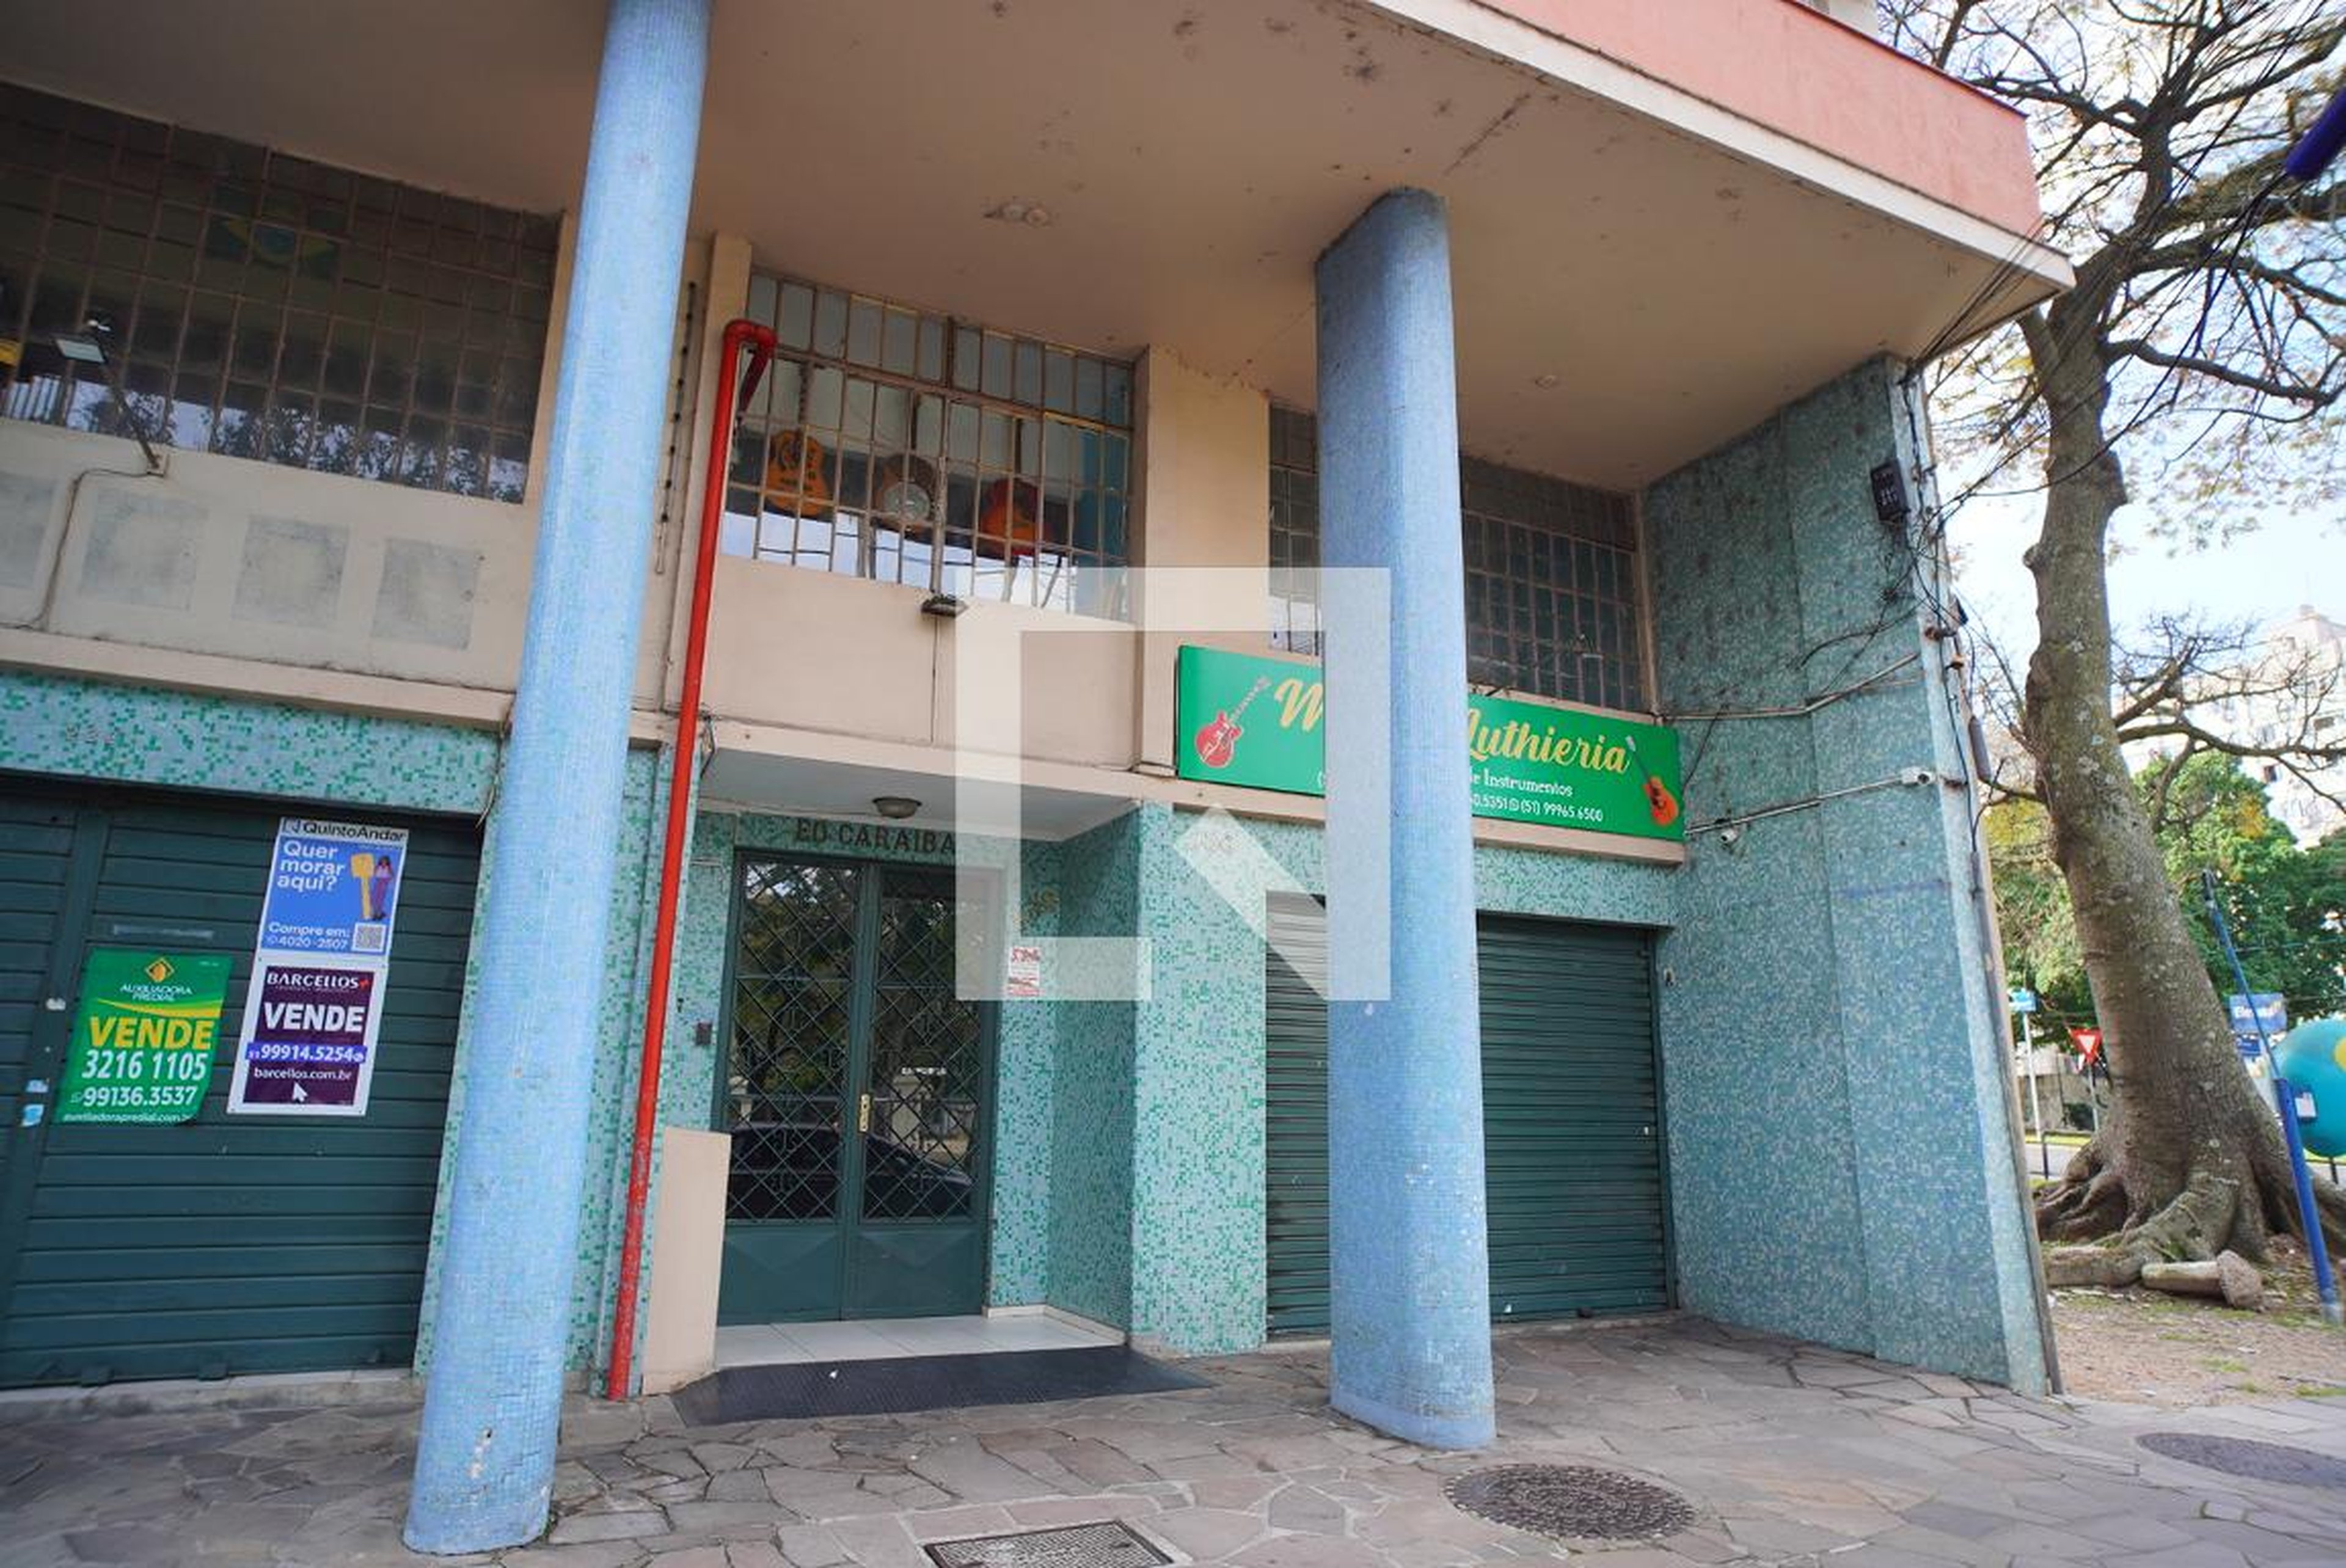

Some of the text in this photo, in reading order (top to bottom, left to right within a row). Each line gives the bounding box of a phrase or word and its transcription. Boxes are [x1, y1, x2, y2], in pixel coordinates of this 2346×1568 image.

[1483, 767, 1573, 797] Instrumentos
[304, 822, 407, 842] QuintoAndar
[283, 840, 339, 860] Quer
[280, 858, 345, 877] morar
[277, 875, 338, 892] aqui?
[269, 921, 323, 937] Compre
[266, 972, 360, 989] BARCELLOS
[263, 1002, 365, 1032] VENDE
[89, 1016, 214, 1050] VENDE
[261, 1043, 353, 1062] 99914.5254
[81, 1049, 209, 1081] 3216 1105
[254, 1067, 353, 1081] barcellos.com.br
[83, 1085, 199, 1107] 99136.3537
